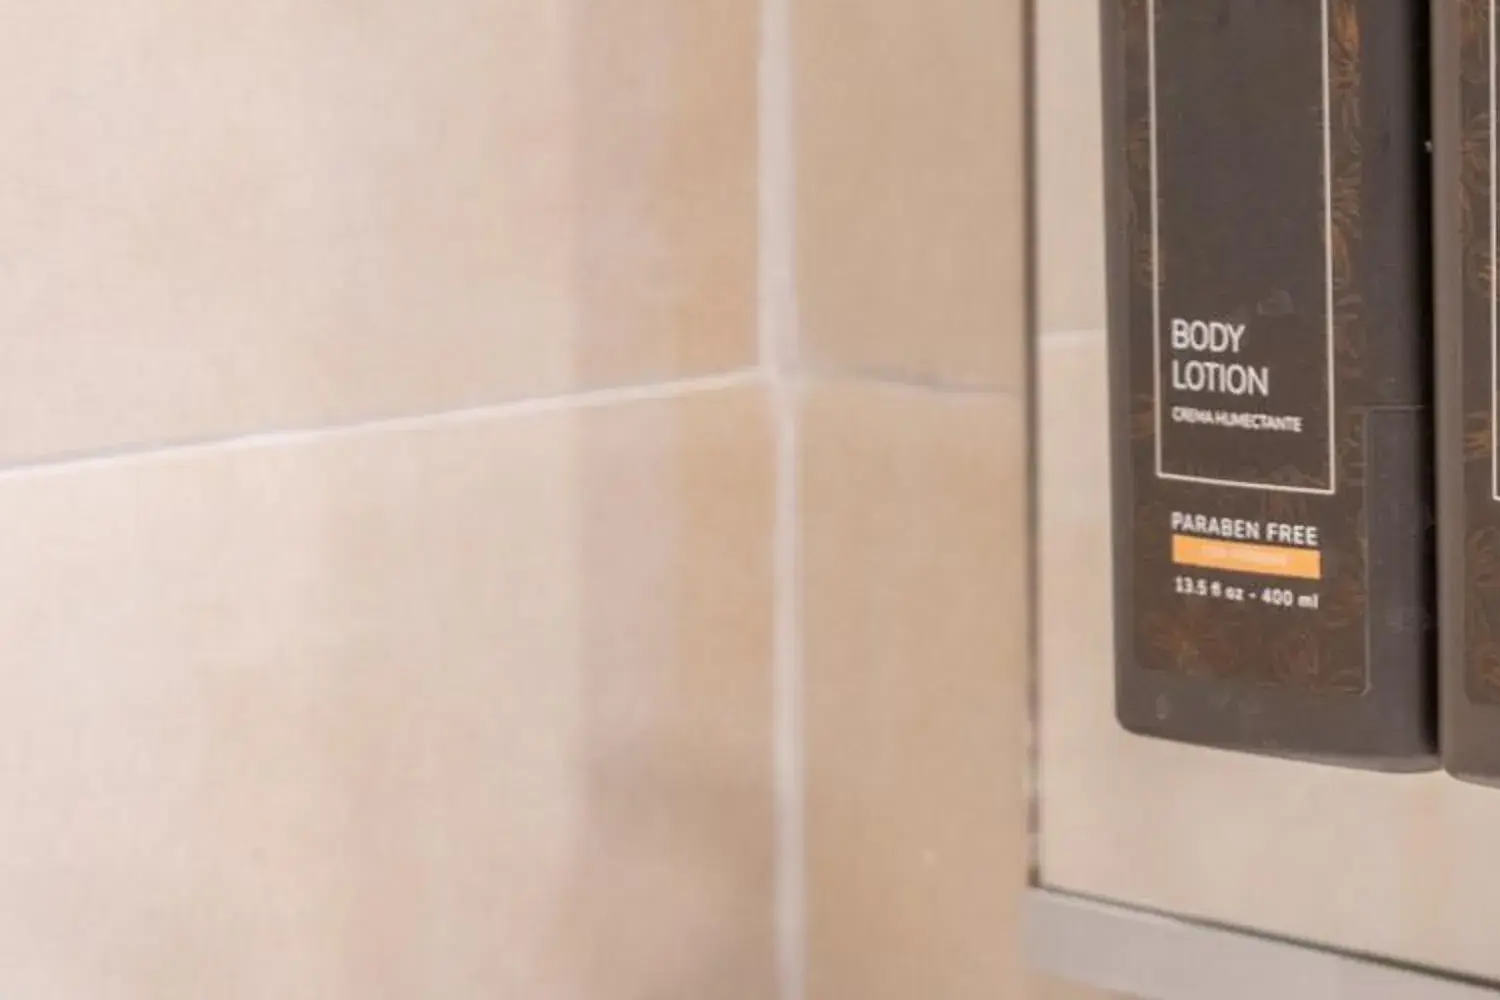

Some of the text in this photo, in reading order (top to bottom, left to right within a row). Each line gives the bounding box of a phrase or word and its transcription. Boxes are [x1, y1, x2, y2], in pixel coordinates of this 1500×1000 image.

[1171, 317, 1246, 353] BODY
[1171, 359, 1269, 397] LOTION
[1171, 406, 1303, 433] CREMA HUMECTANTE
[1170, 511, 1319, 546] PARABEN FREE
[1174, 575, 1208, 597] 13.5
[1209, 580, 1222, 598] fl
[1225, 586, 1245, 602] oz
[1260, 587, 1294, 607] 400
[1297, 592, 1320, 610] ml
